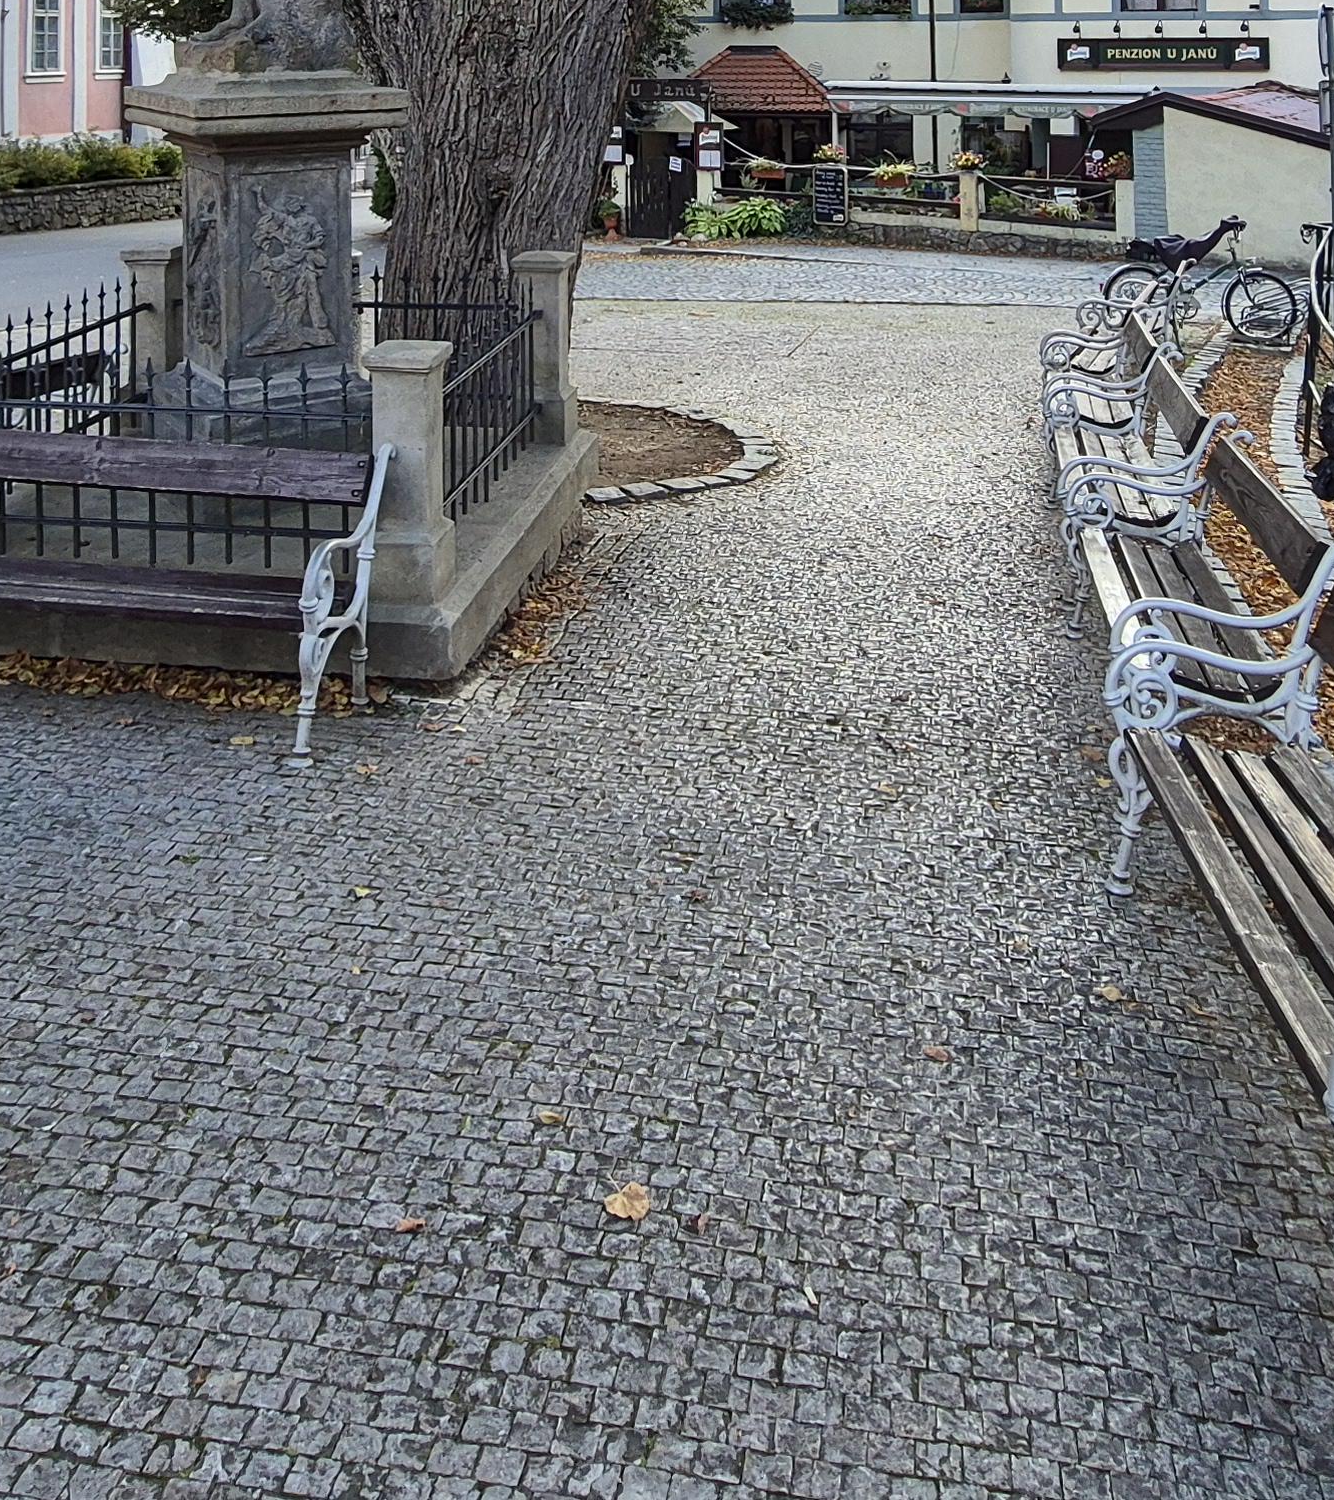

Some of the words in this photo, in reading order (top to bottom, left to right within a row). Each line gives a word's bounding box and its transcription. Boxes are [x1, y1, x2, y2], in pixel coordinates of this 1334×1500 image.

[1107, 48, 1161, 59] PENZION
[1167, 48, 1177, 59] U
[1181, 46, 1217, 62] JANŮ
[630, 84, 642, 97] U
